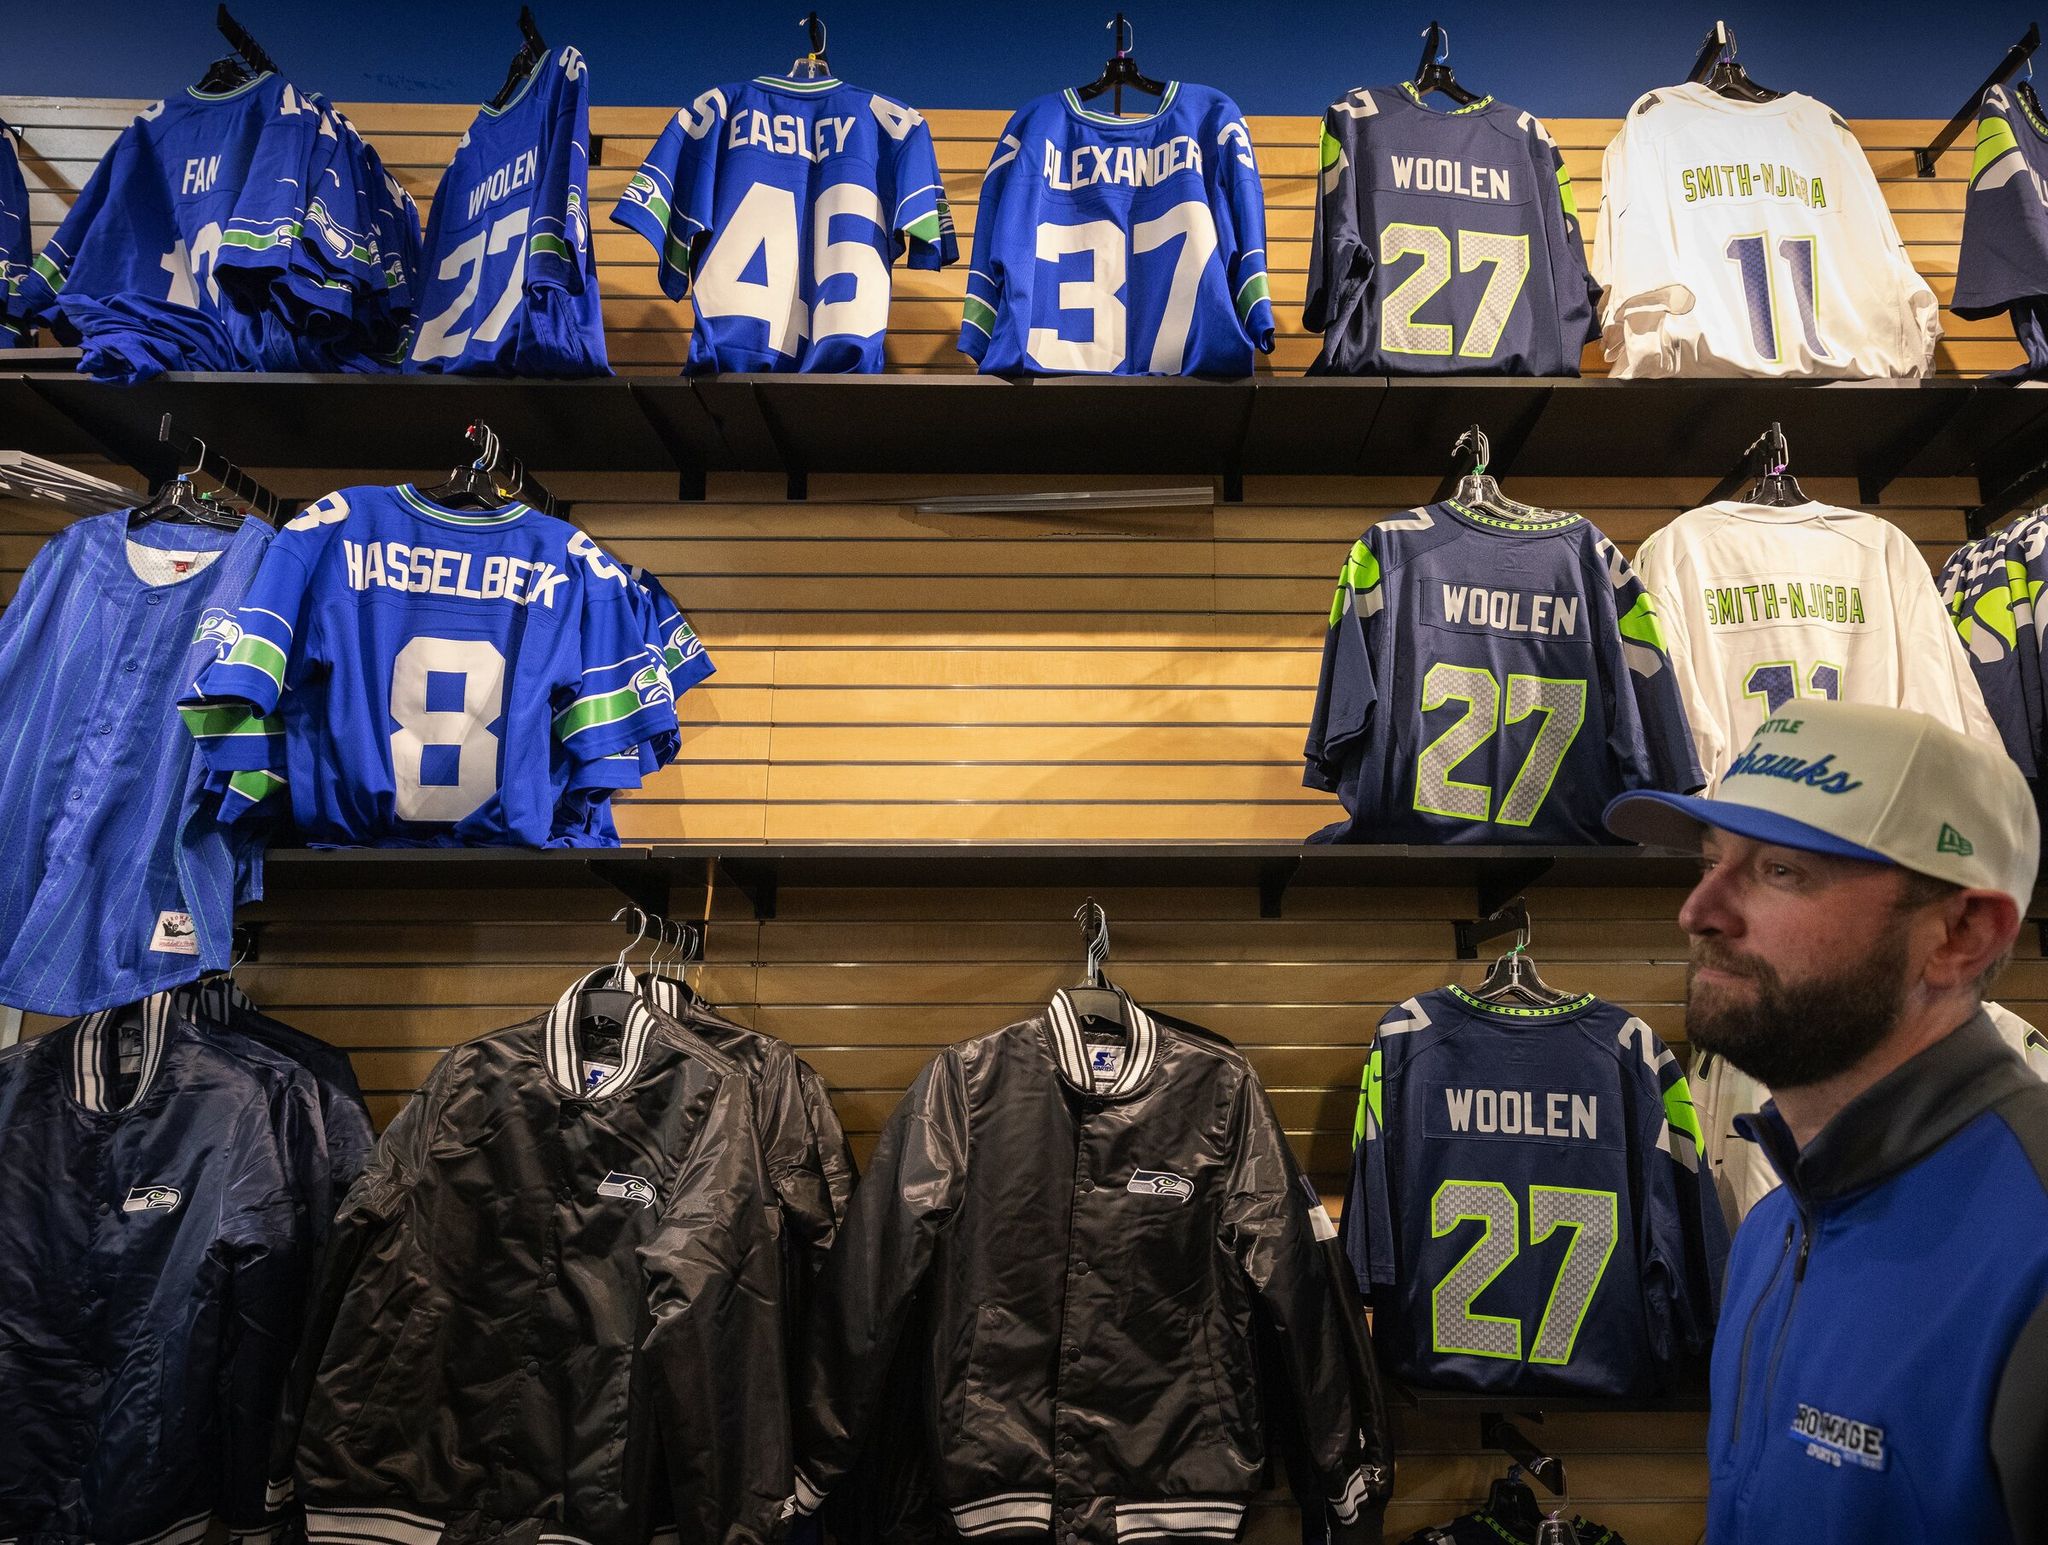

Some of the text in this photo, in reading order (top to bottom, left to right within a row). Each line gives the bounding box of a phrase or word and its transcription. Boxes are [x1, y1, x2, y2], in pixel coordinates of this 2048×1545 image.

[728, 109, 855, 164] EASLEY
[869, 94, 924, 141] 4
[181, 153, 222, 195] FAN
[467, 145, 538, 221] WOOLEN
[1043, 135, 1203, 191] ALEXANDER
[1391, 155, 1511, 201] WOOLEN
[1682, 163, 1827, 209] SMITH-NJIGBA
[411, 206, 530, 362] 27
[693, 182, 890, 358] 45
[1025, 201, 1219, 376] 37
[1380, 222, 1530, 359] 27
[1724, 230, 1836, 364] 11
[343, 540, 569, 609] HASSELBECK
[1704, 582, 1865, 625] SMITH-NJIGBA
[1442, 584, 1578, 636] WOOLEN
[390, 636, 506, 822] 8
[1413, 662, 1588, 828] 27
[1753, 718, 1805, 737] ATTLE
[1445, 1088, 1597, 1140] WOOLEN
[1431, 1179, 1618, 1366] 27
